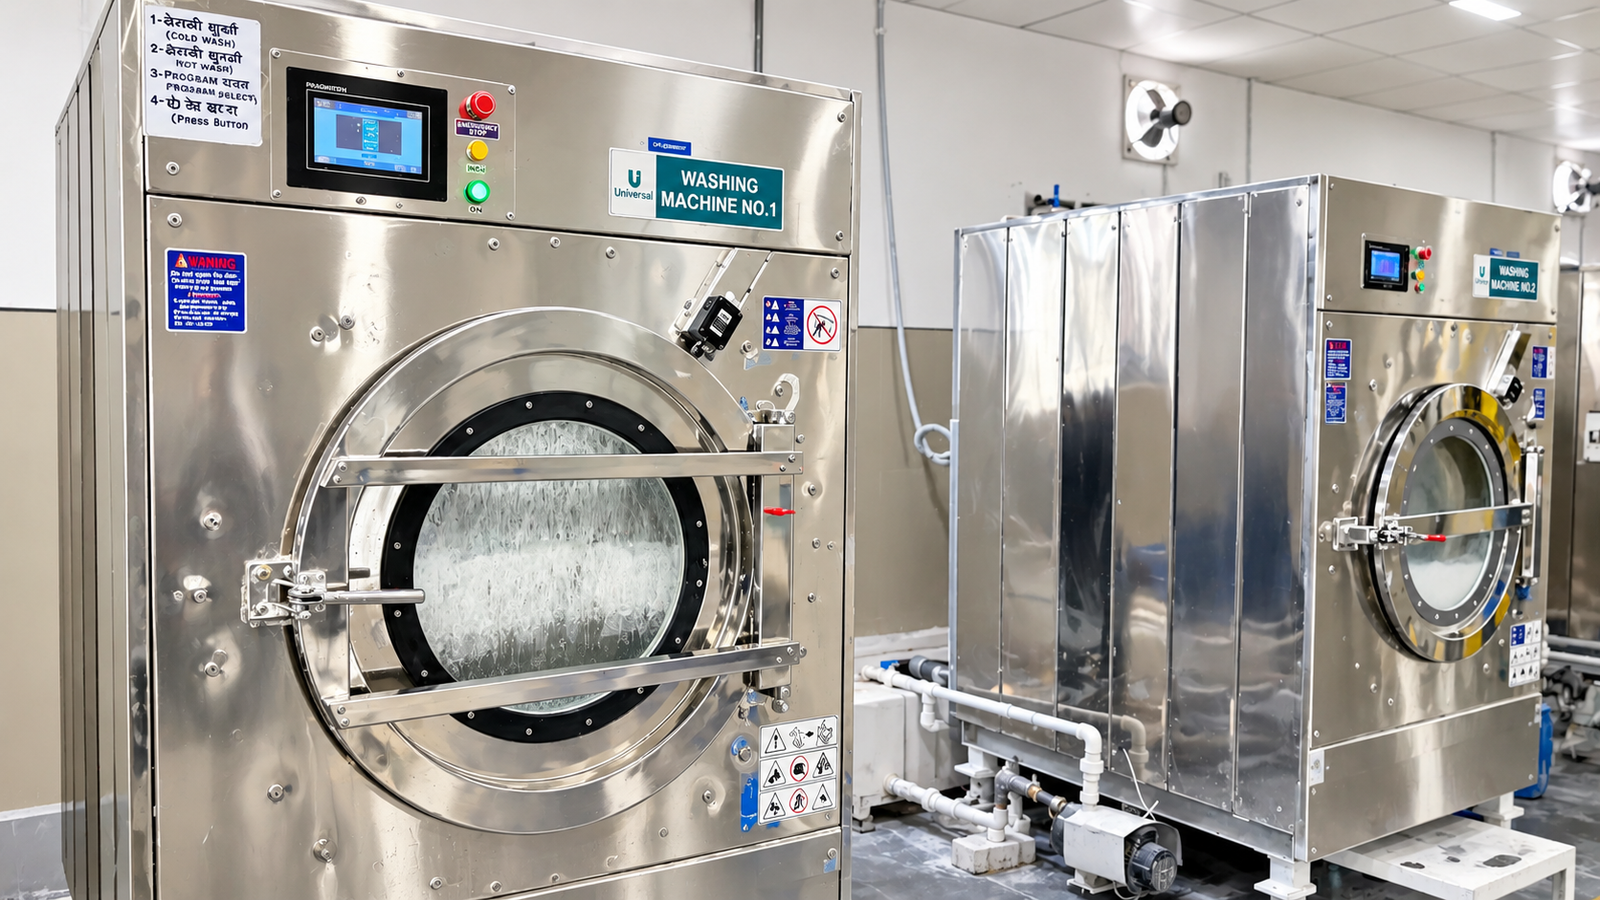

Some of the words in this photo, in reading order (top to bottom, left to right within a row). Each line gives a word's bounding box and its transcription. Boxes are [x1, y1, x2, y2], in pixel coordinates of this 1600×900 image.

[681, 170, 758, 194] WASHING
[614, 187, 653, 200] Universal
[469, 205, 483, 213] ON
[661, 190, 738, 214] MACHINE
[742, 199, 776, 217] NO.1
[1499, 265, 1530, 279] WASHING
[1491, 279, 1520, 292] MACHINE
[1520, 281, 1536, 293] NO.2
